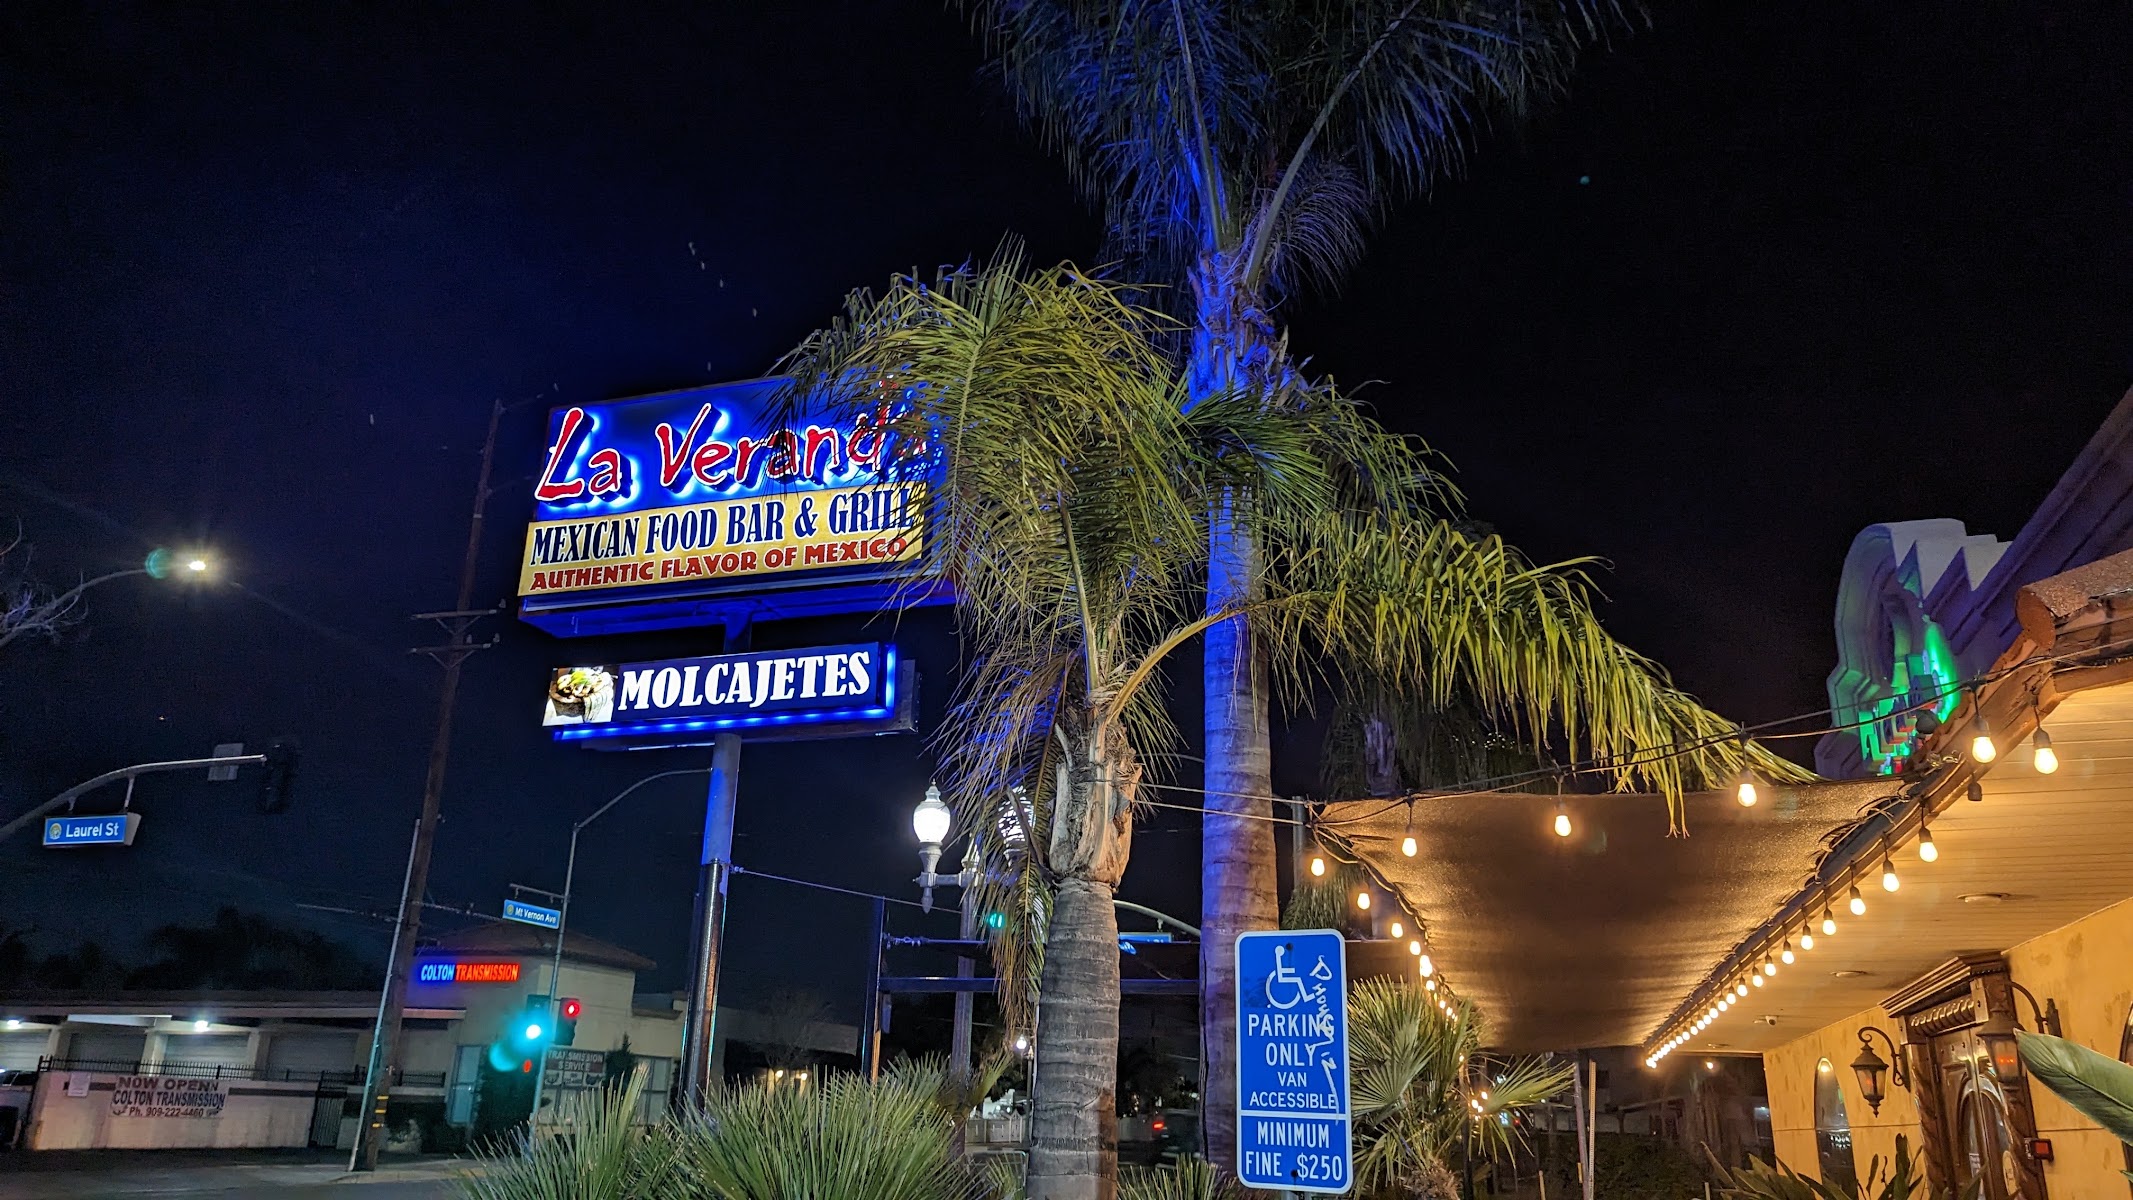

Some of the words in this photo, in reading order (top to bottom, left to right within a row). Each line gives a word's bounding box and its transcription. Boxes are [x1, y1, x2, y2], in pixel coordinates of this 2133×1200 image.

[534, 407, 622, 501] La
[655, 400, 928, 488] Verand
[530, 517, 640, 565] MEXICAN
[645, 507, 718, 552] FOOD
[726, 500, 785, 545] BAR
[794, 496, 818, 538] &
[828, 486, 914, 535] GRILL
[529, 560, 655, 591] AUTHENTIC
[660, 551, 757, 579] FLAVOR
[764, 546, 798, 570] OF
[804, 536, 908, 565] MEXICO
[617, 651, 870, 711] MOLCAJETES
[65, 823, 103, 838] Laurel
[105, 822, 119, 836] St
[514, 906, 523, 918] Mt
[523, 908, 545, 922] Vernon
[544, 913, 557, 924] Ave
[420, 964, 455, 981] COLTON
[455, 964, 519, 981] TRANSMISSION
[1247, 1013, 1335, 1038] PARKING
[1264, 1042, 1316, 1067] ONLY
[117, 1077, 158, 1089] NOW
[1276, 1071, 1308, 1088] VAN
[113, 1090, 154, 1105] COLTON
[156, 1091, 226, 1108] TRANSMISSION
[1249, 1091, 1337, 1111] ACCESSIBLE
[1256, 1120, 1331, 1149] MINIMUM
[1244, 1150, 1283, 1177] FINE
[1296, 1152, 1344, 1182] $250
